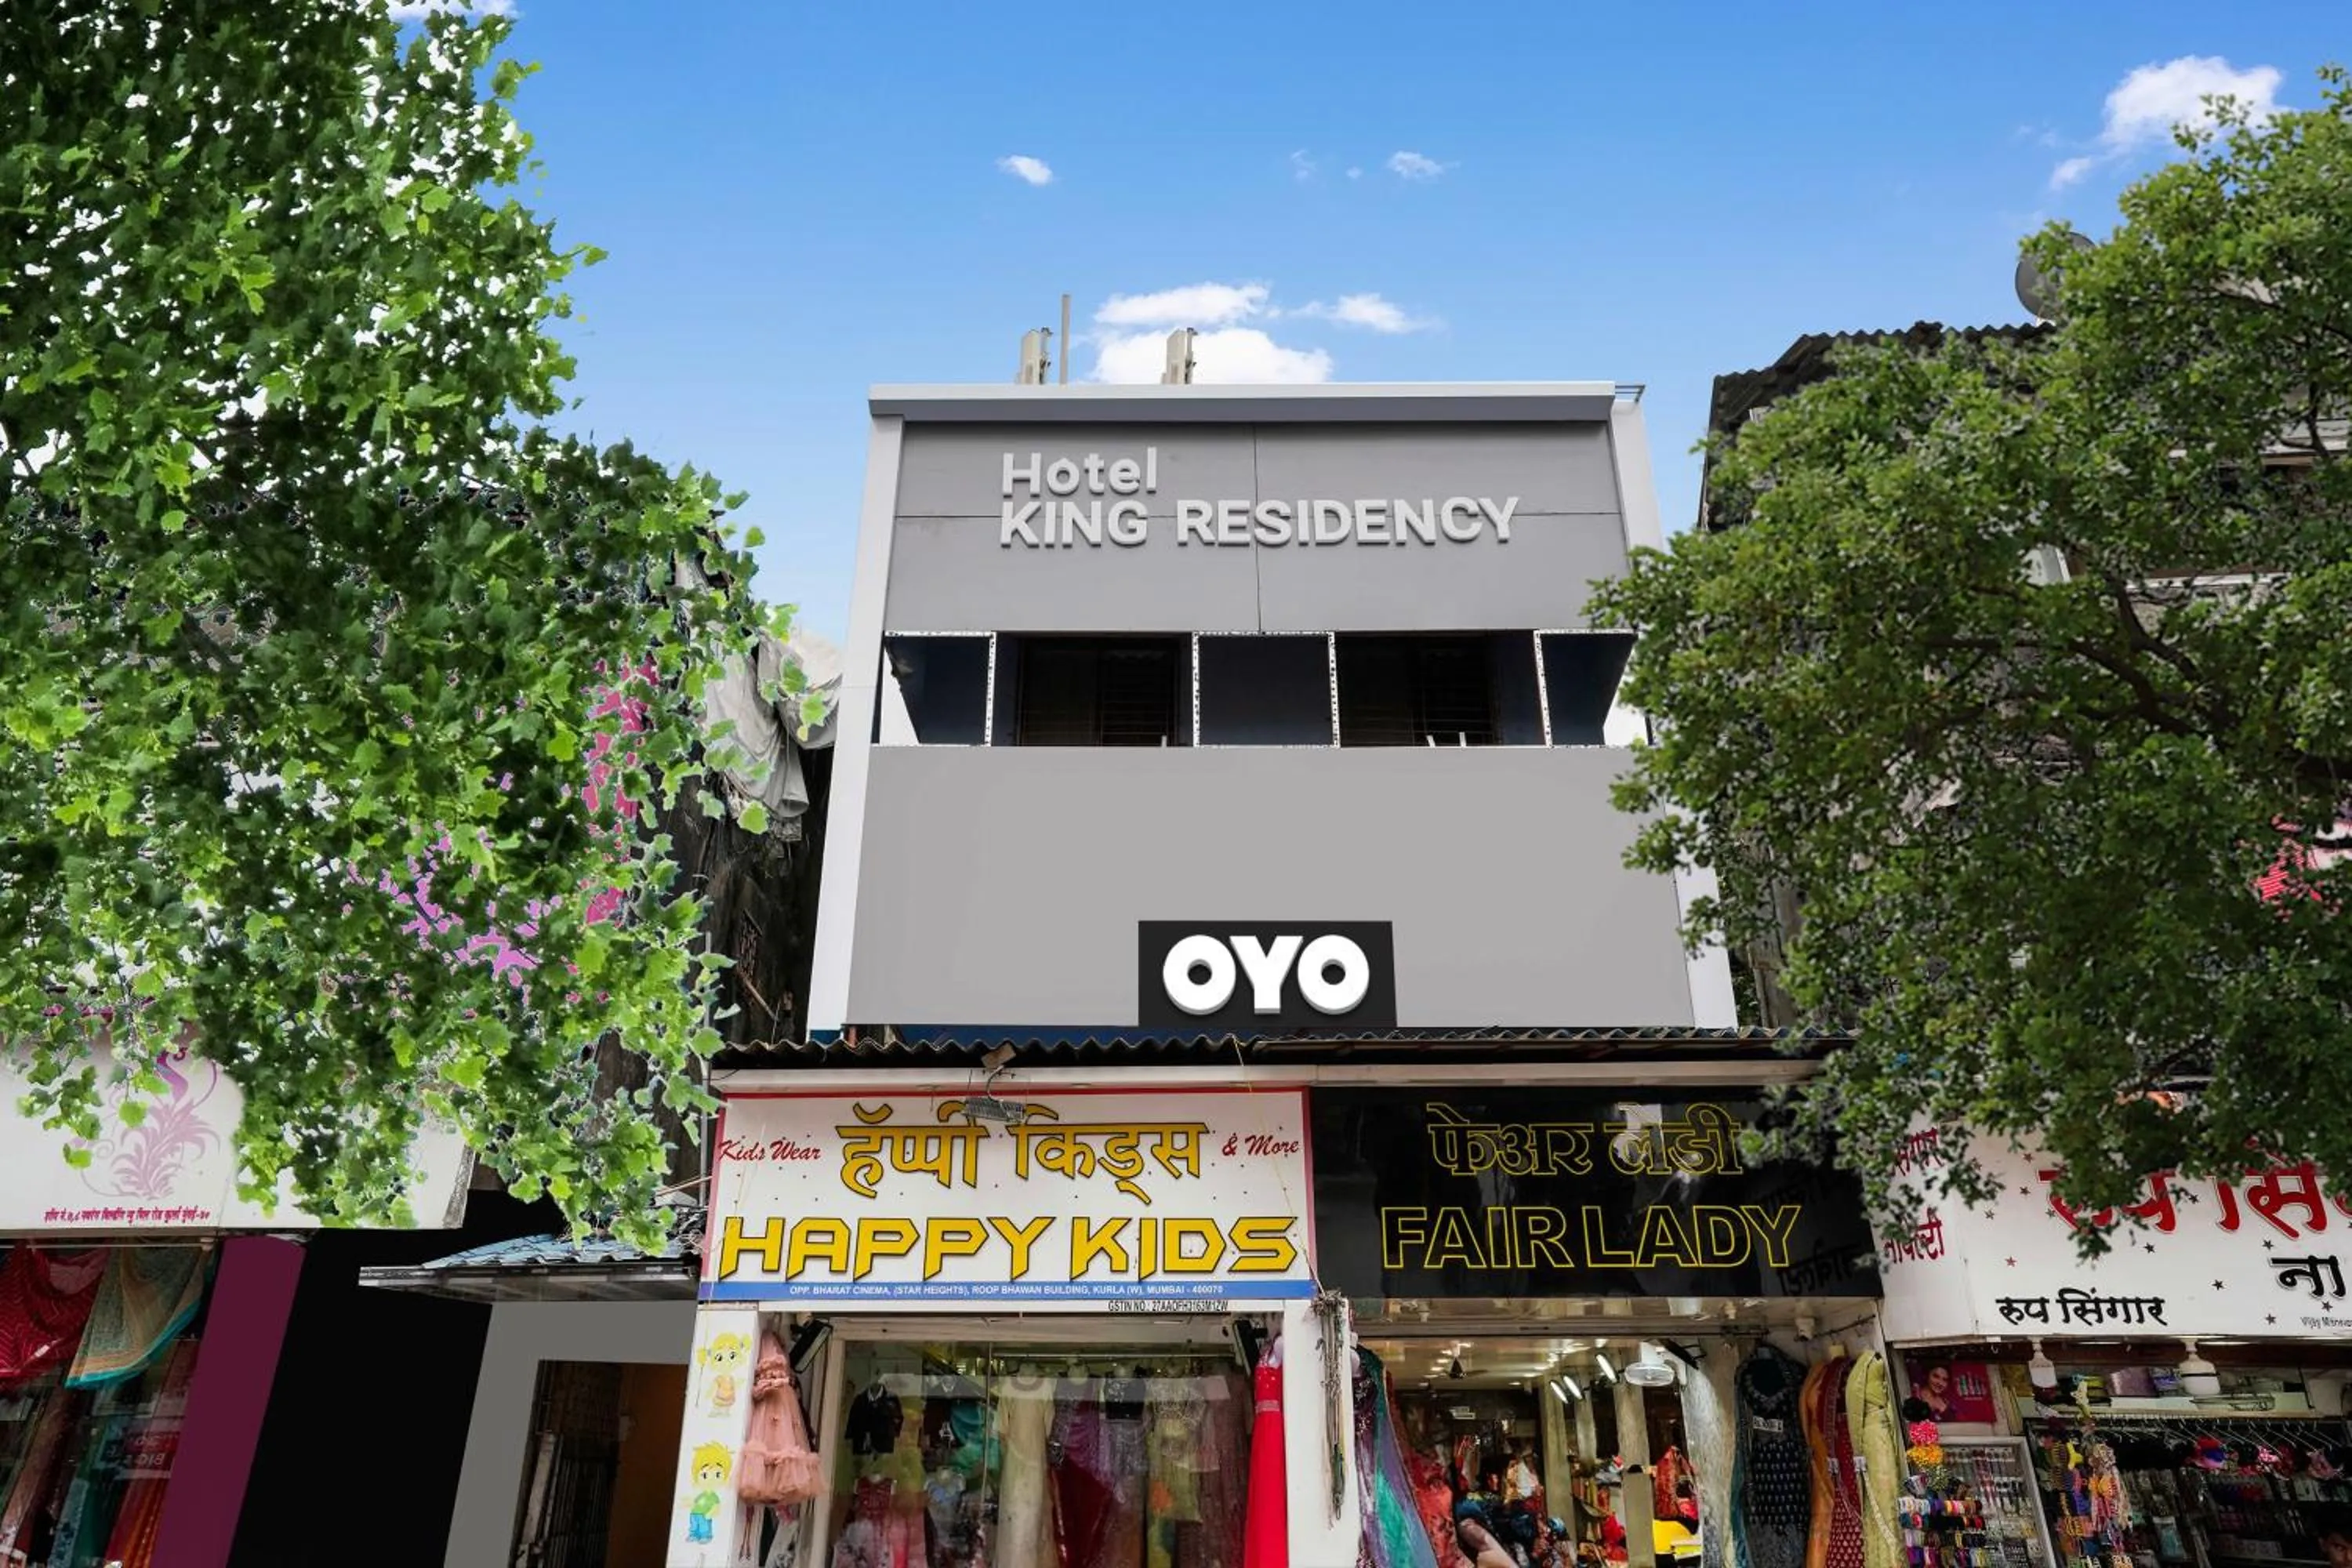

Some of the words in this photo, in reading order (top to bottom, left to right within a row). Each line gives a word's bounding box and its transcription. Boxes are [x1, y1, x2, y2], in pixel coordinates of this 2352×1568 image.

[1001, 446, 1158, 497] Hotel
[1000, 500, 1148, 547] KING
[1176, 495, 1520, 546] RESIDENCY
[1163, 935, 1370, 1015] OYO
[719, 1139, 765, 1161] Kids
[770, 1140, 821, 1161] Wear
[1221, 1133, 1238, 1156] &
[1244, 1134, 1299, 1156] More
[717, 1215, 1054, 1282] HAPPY
[1069, 1215, 1299, 1282] KIDS
[1381, 1206, 1574, 1269] FAIR
[1586, 1204, 1801, 1268] LADY
[812, 1285, 851, 1295] BHARAT
[971, 1285, 1000, 1295] ROOP
[1001, 1284, 1042, 1294] BHAWAN
[1093, 1284, 1125, 1294] KURLA
[1146, 1284, 1185, 1294] MUMBAI
[2055, 1287, 2168, 1327] सिंगार
